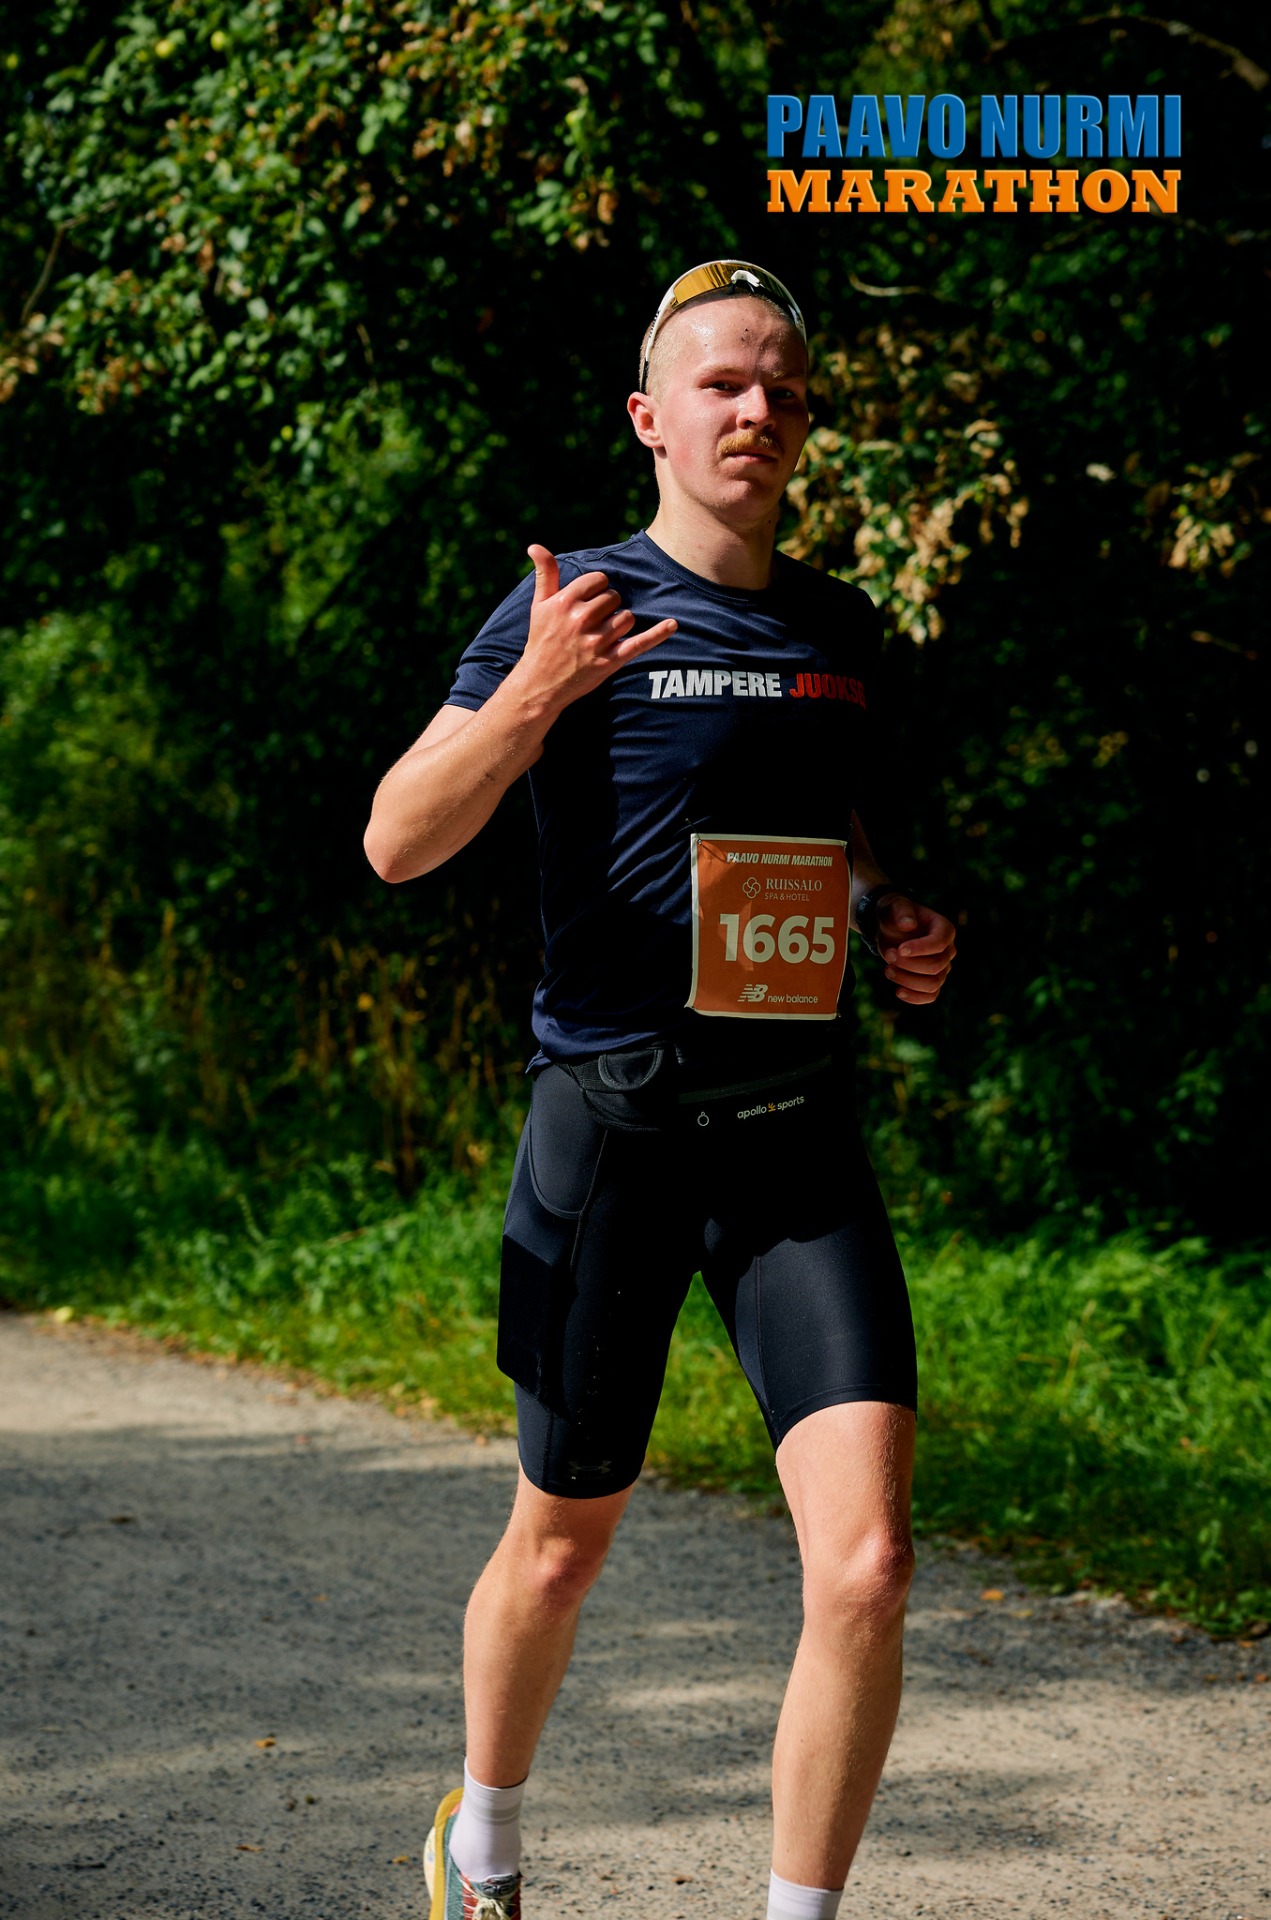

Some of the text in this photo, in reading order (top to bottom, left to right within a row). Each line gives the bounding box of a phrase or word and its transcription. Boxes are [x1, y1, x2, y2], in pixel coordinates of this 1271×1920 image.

[648, 669, 783, 700] TAMPERE
[726, 852, 833, 867] PAAVO NURMI MARATHON
[765, 878, 822, 891] RUISSALO
[719, 913, 836, 965] 1665
[767, 995, 785, 1003] new
[785, 994, 819, 1004] balance
[737, 1096, 805, 1120] apollo sports
